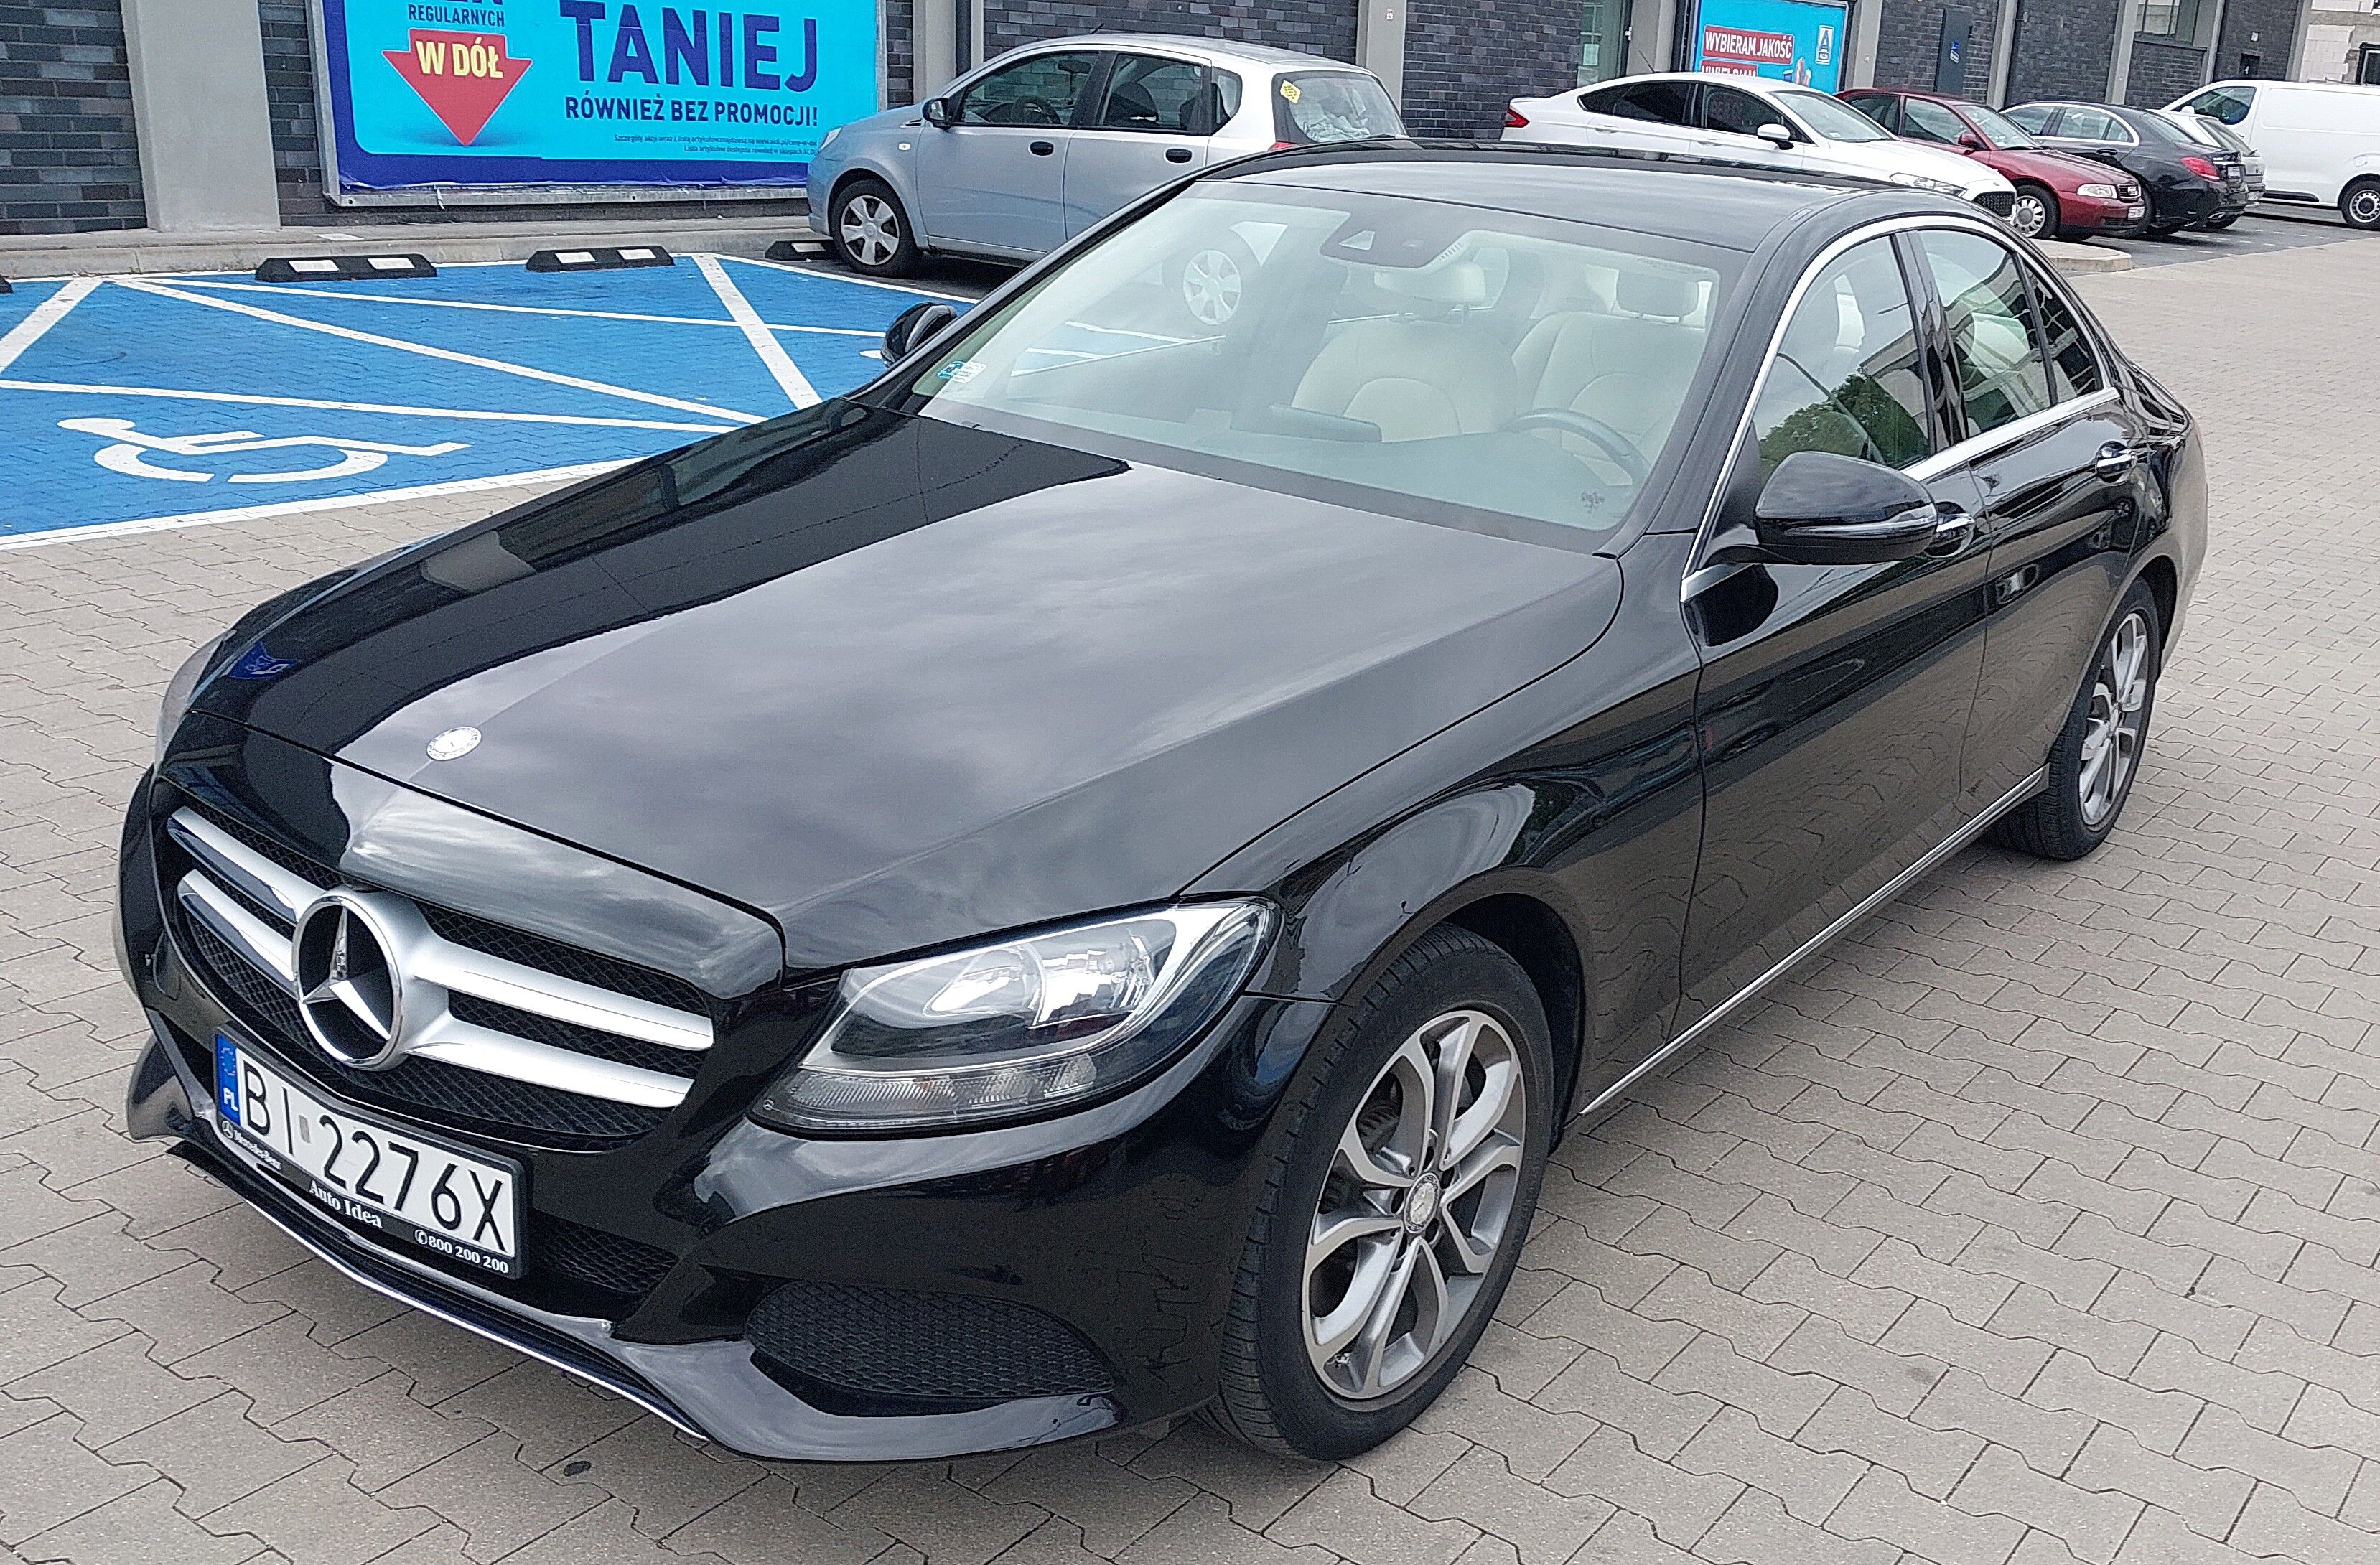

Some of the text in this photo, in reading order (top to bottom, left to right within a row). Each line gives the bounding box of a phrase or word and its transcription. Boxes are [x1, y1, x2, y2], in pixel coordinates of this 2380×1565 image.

[408, 4, 505, 27] REGULARNYCH
[415, 37, 503, 78] W DÓŁ
[559, 0, 818, 93] TANIEJ
[1704, 31, 1793, 59] WYBIERAM JAKOŚĆ
[565, 90, 818, 127] RÓWNIEŻ BEZ PROMOCJI!
[223, 1087, 238, 1112] PL
[243, 1057, 508, 1254] BI 2276X
[309, 1180, 383, 1230] Auto Idea
[428, 1235, 510, 1275] 800 200 200
